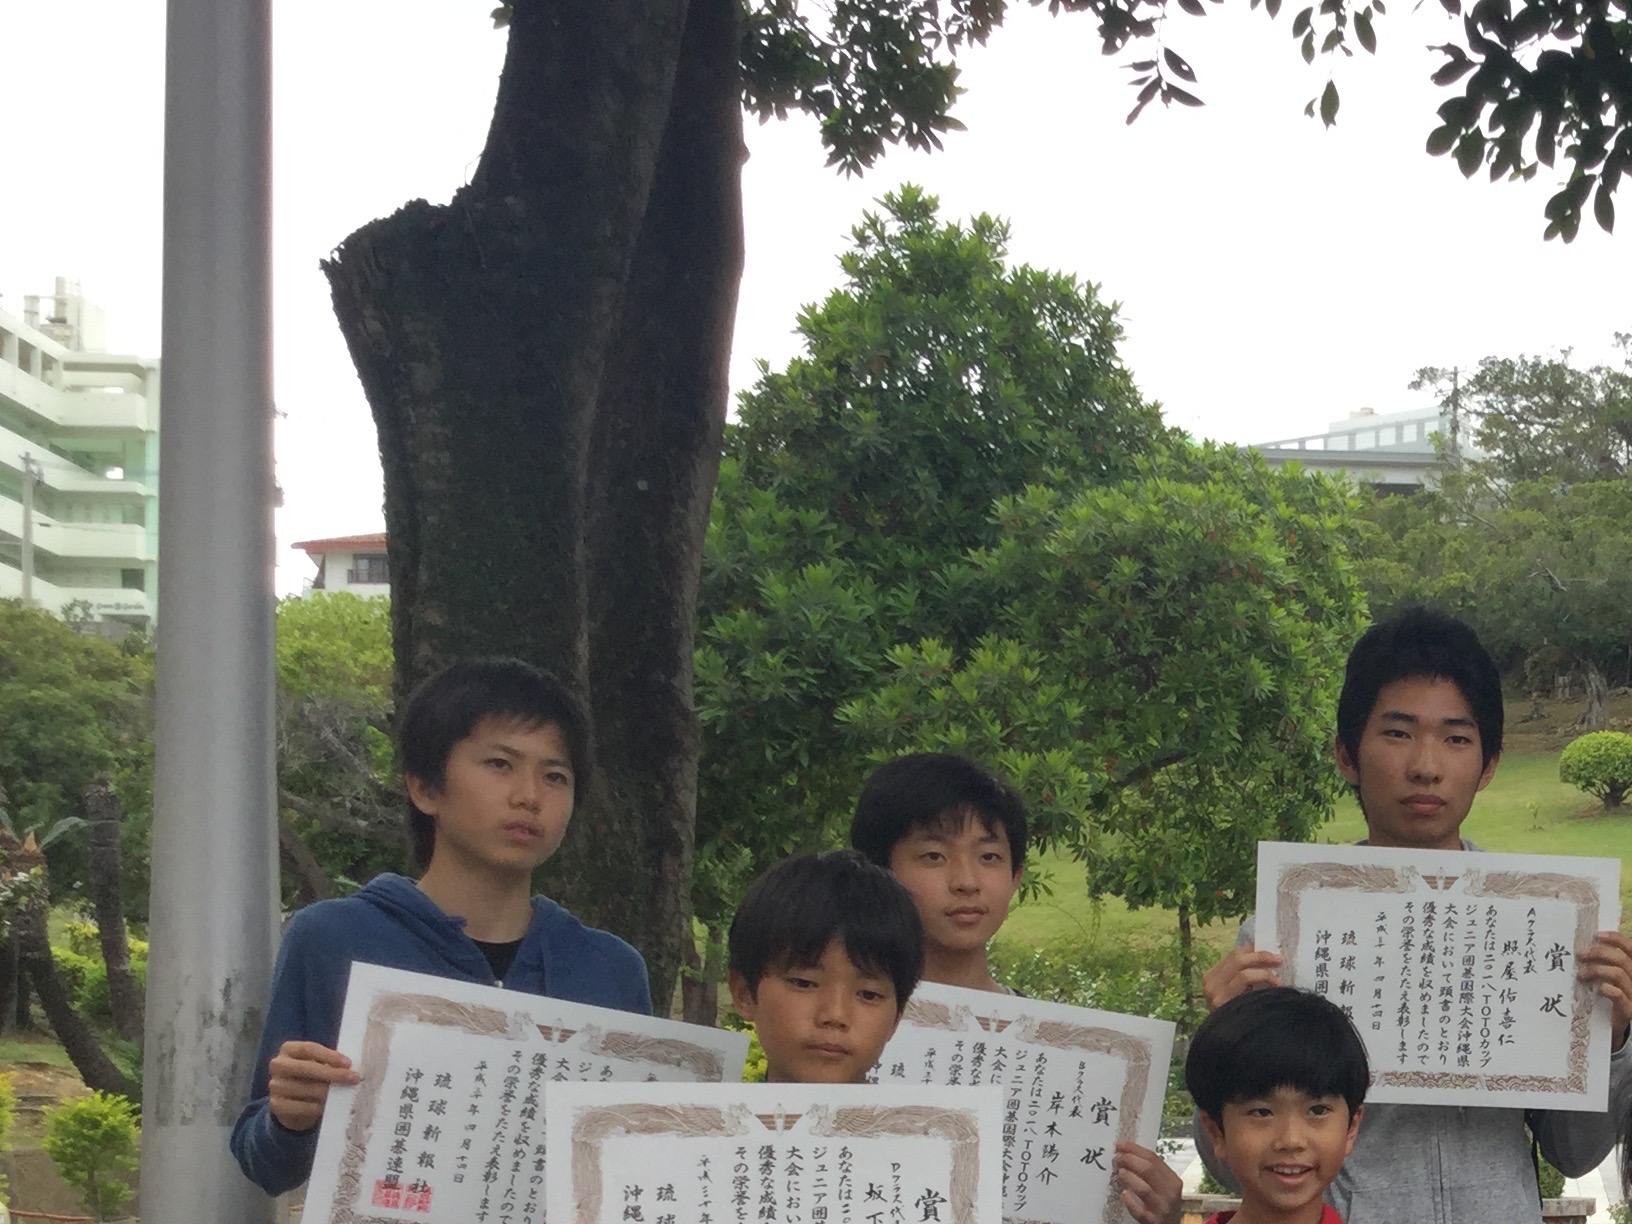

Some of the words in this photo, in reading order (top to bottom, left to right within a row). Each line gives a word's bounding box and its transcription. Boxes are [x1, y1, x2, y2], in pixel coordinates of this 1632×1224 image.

[1314, 930, 1332, 994] 沖縄県囲
[1397, 902, 1414, 1066] その栄誉をたたえ表彰します
[1417, 901, 1437, 1066] 優秀な成績を収めましたので
[1438, 903, 1457, 1066] 大会において頭書のとおり
[1456, 905, 1476, 1067] ジュニア囲碁国際大会沖縄県
[1540, 942, 1571, 1017] 賞状
[410, 1073, 452, 1193] 琉球新報社
[1081, 1097, 1117, 1170] 賞状
